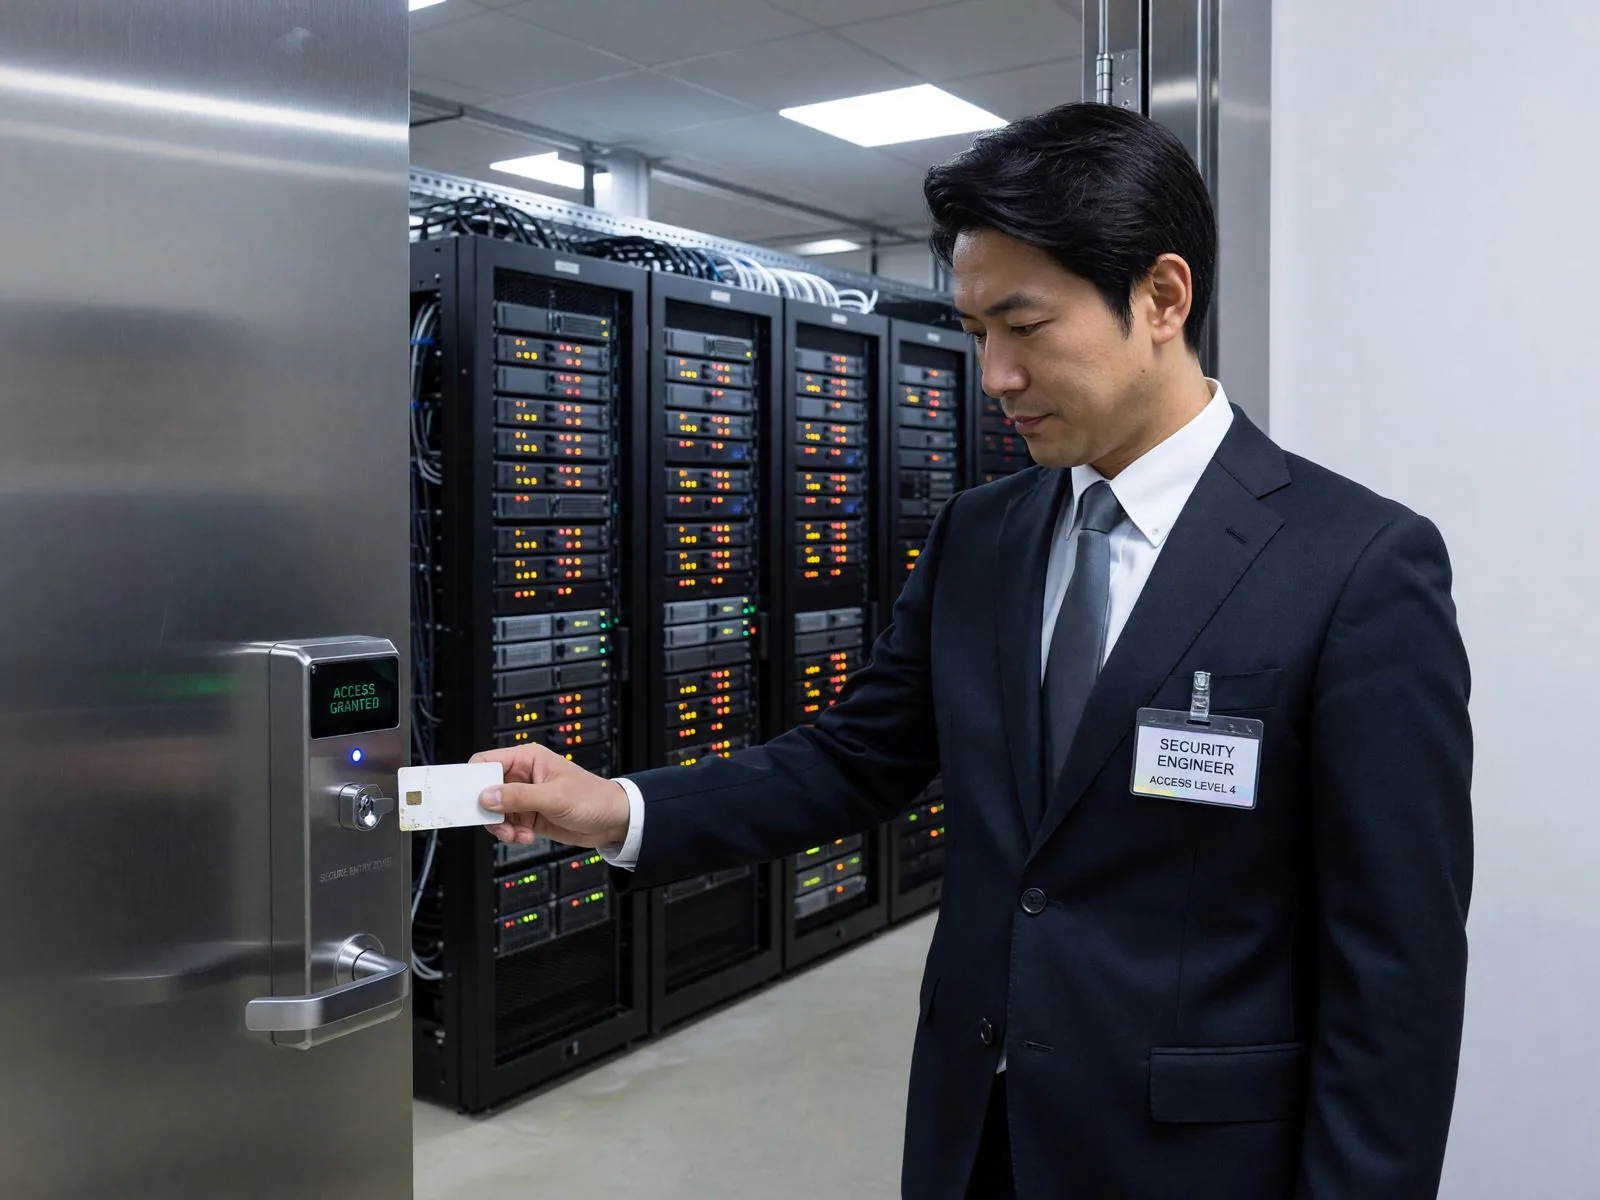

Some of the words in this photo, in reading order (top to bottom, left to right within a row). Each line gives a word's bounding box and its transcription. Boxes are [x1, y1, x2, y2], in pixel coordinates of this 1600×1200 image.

[333, 683, 376, 699] ACCESS
[330, 697, 380, 714] GRANTED
[1159, 738, 1235, 758] SECURITY
[1157, 755, 1234, 776] ENGINEER
[1149, 776, 1192, 788] ACCESS
[1194, 781, 1227, 793] LEVEL
[1229, 785, 1236, 794] 4
[319, 868, 348, 882] SECURE
